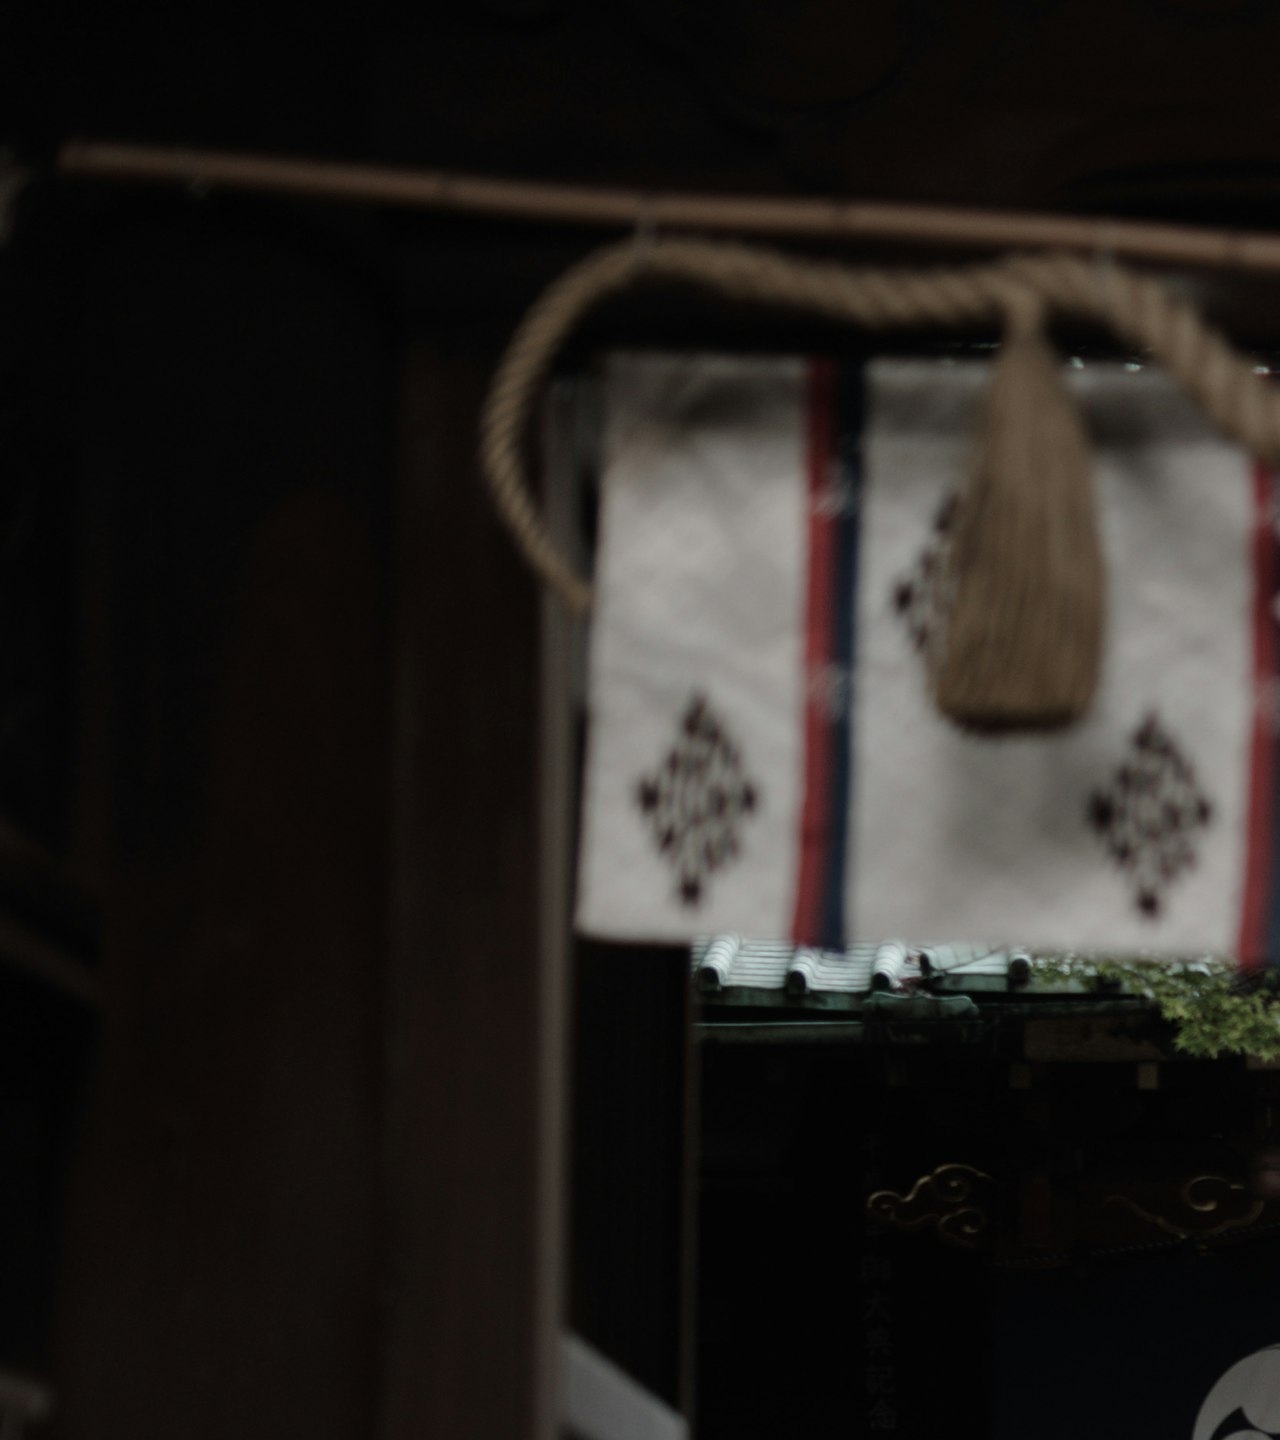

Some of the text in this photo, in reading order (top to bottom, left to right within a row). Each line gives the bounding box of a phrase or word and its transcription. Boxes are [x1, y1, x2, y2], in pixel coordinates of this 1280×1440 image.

[858, 1131, 898, 1431] 平年御大典記念
